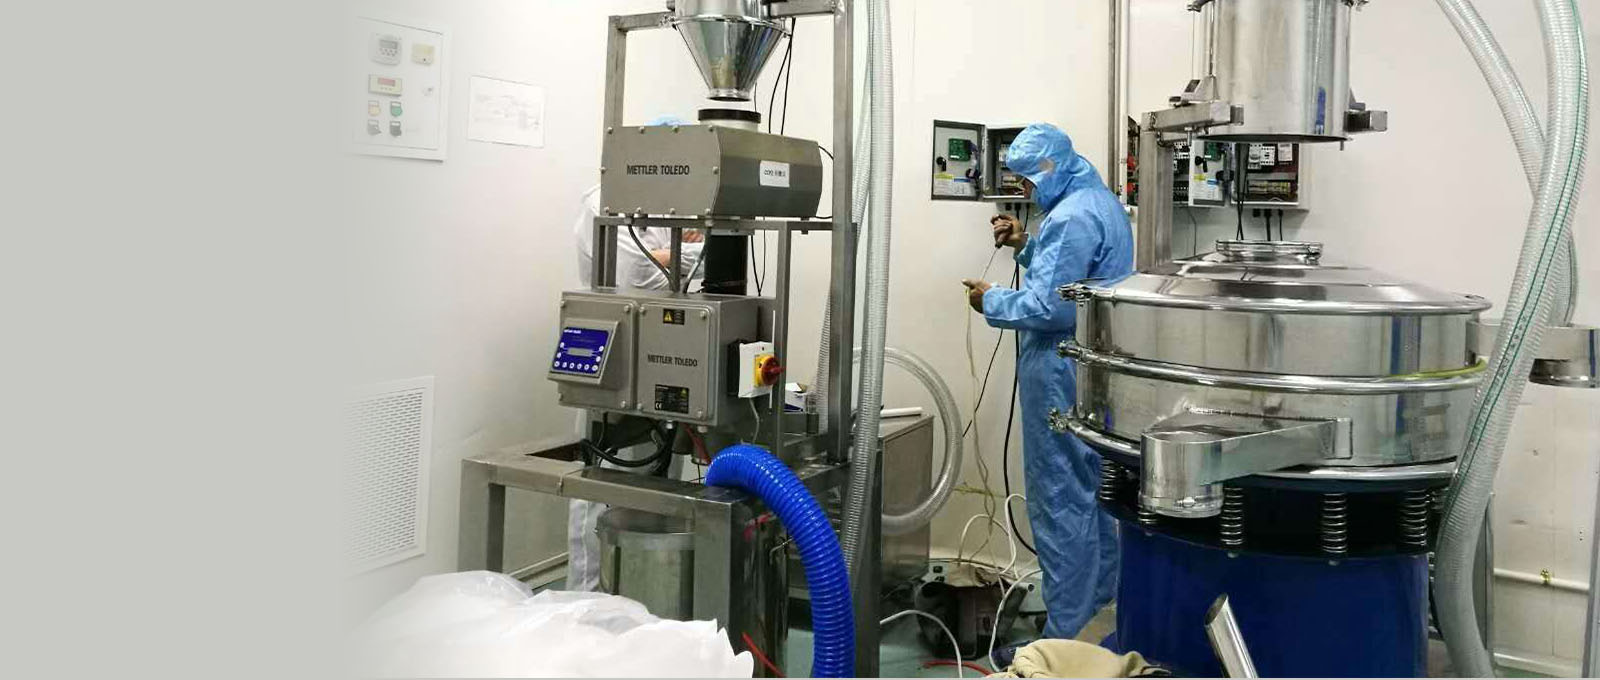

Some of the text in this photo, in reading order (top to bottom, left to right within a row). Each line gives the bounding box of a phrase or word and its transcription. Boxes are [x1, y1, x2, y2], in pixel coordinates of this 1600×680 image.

[626, 164, 690, 176] METTLER TOLEDO
[647, 353, 698, 367] METTLER TOLEDO
